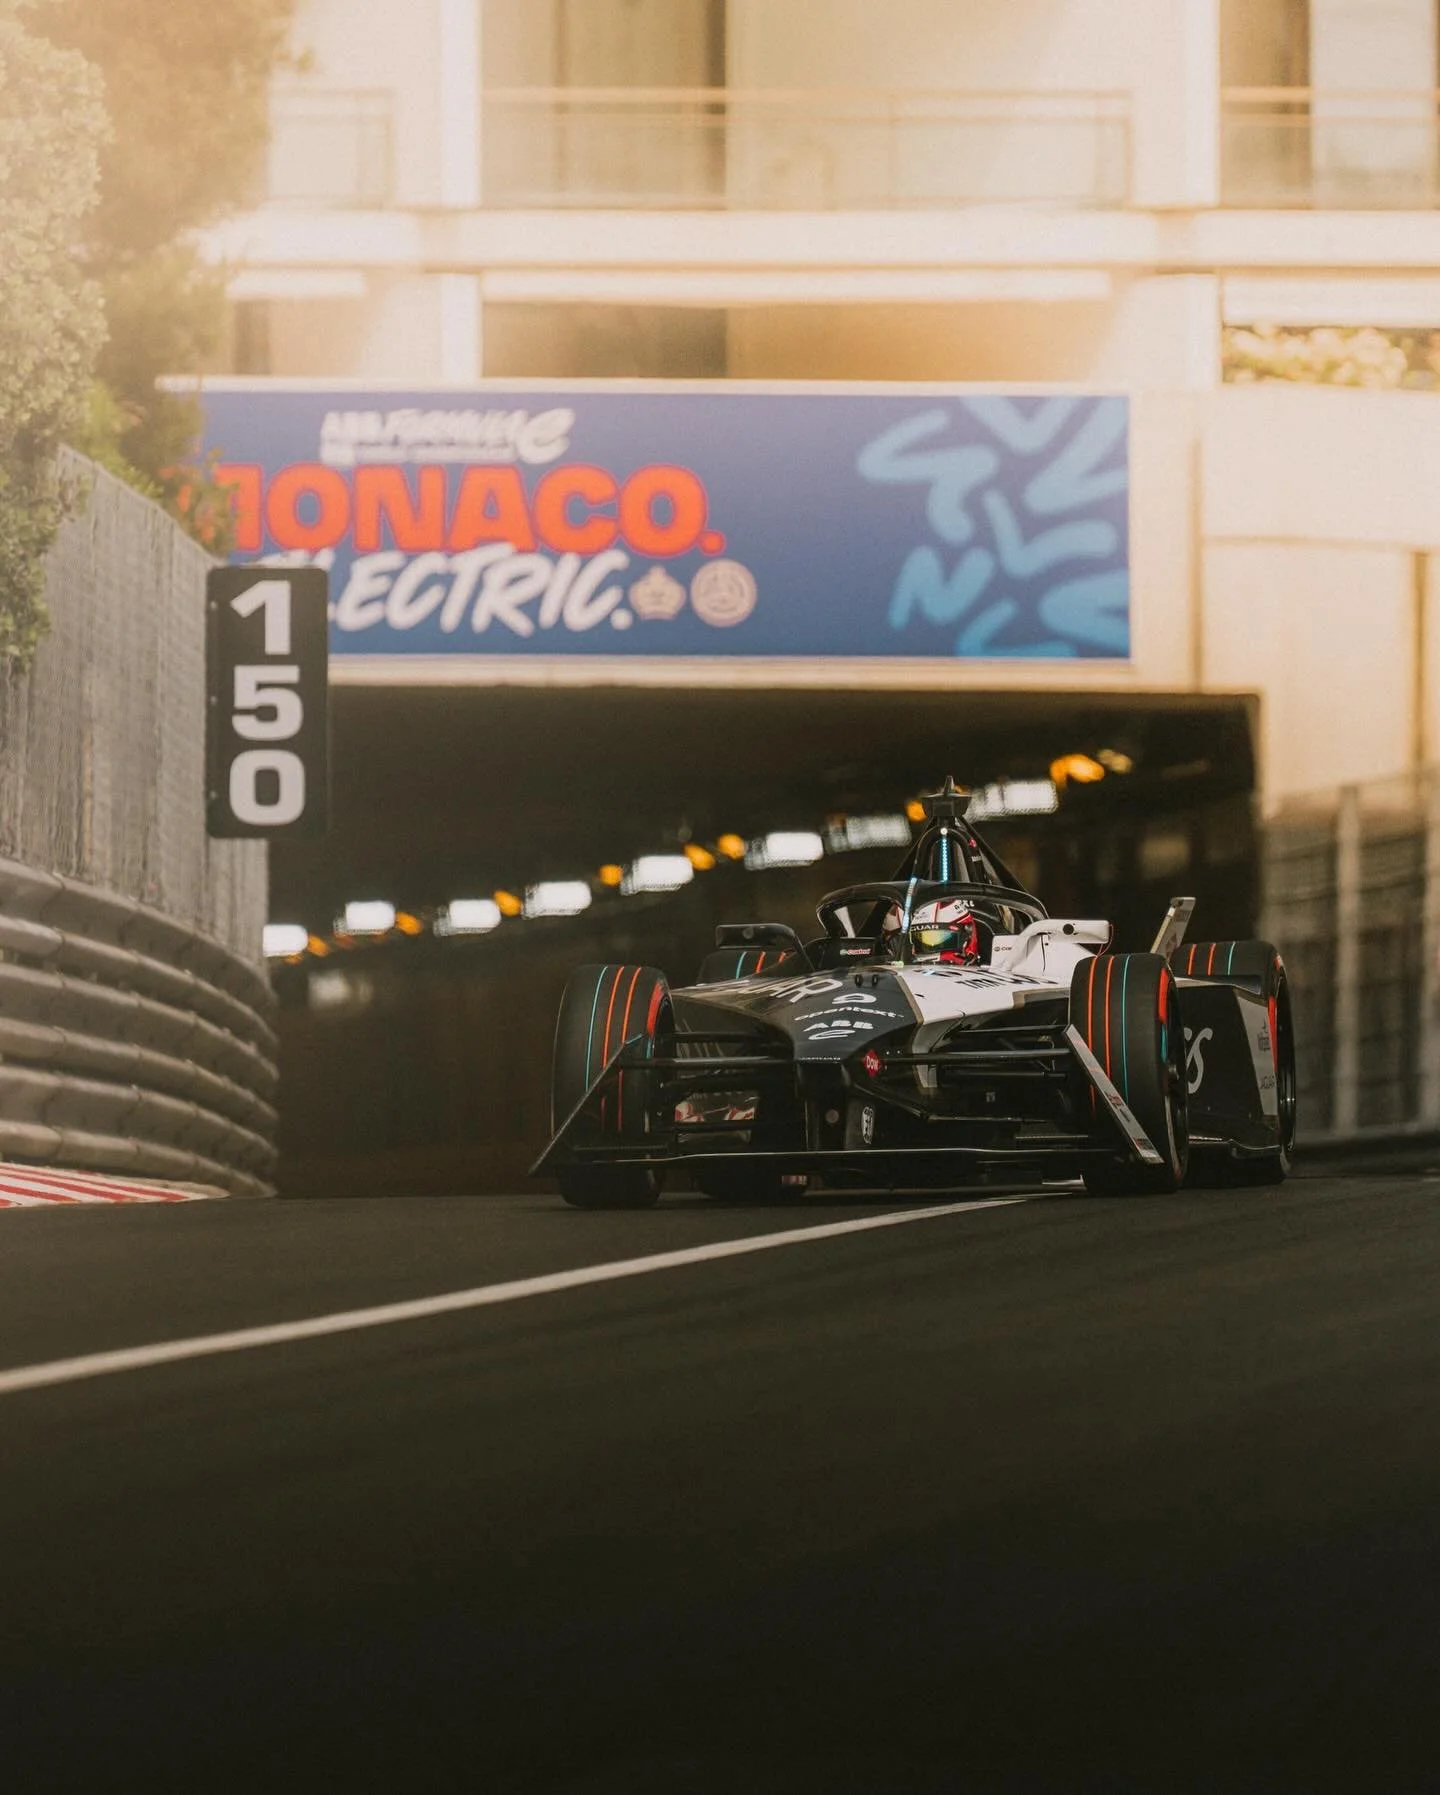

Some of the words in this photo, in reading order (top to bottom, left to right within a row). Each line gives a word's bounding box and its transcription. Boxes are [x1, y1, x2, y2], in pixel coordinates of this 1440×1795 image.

[260, 543, 634, 638] ECTRIC.
[229, 580, 306, 826] 150
[909, 924, 939, 933] GUAR
[803, 1020, 874, 1032] ABB
